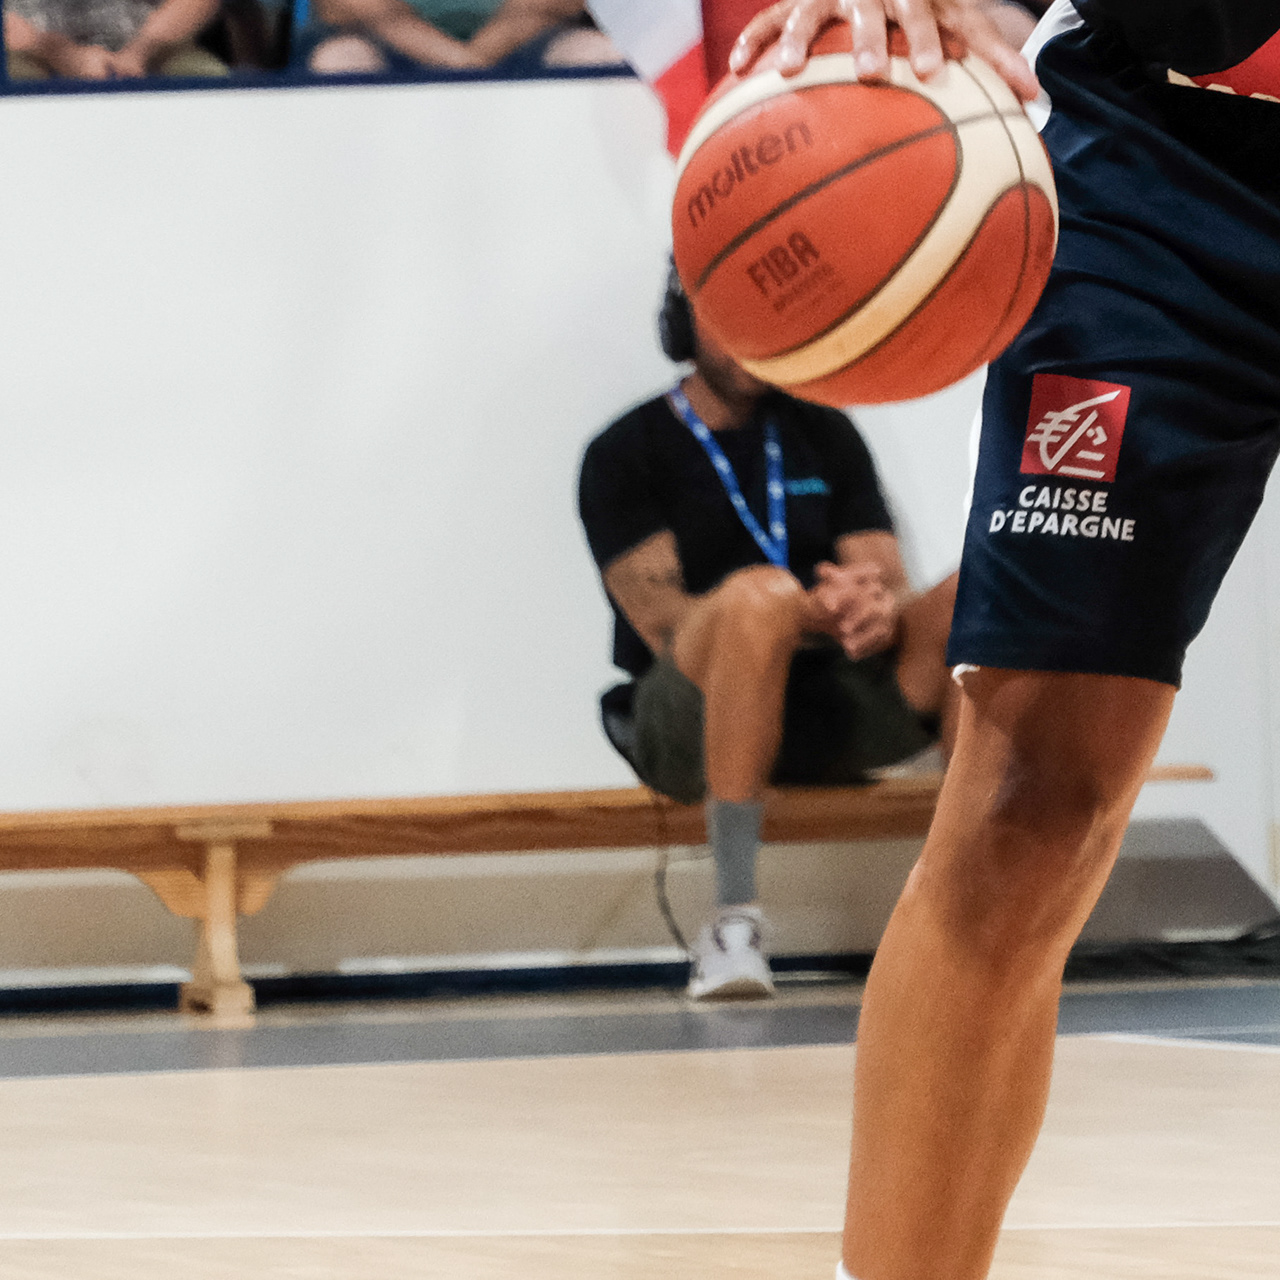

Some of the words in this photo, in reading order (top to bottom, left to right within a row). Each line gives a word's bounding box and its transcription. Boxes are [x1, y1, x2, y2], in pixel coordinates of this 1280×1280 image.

[687, 121, 814, 229] molten
[747, 230, 821, 300] FIBA
[1018, 484, 1109, 514] CAISSE
[987, 509, 1137, 542] D'EPARGNE
